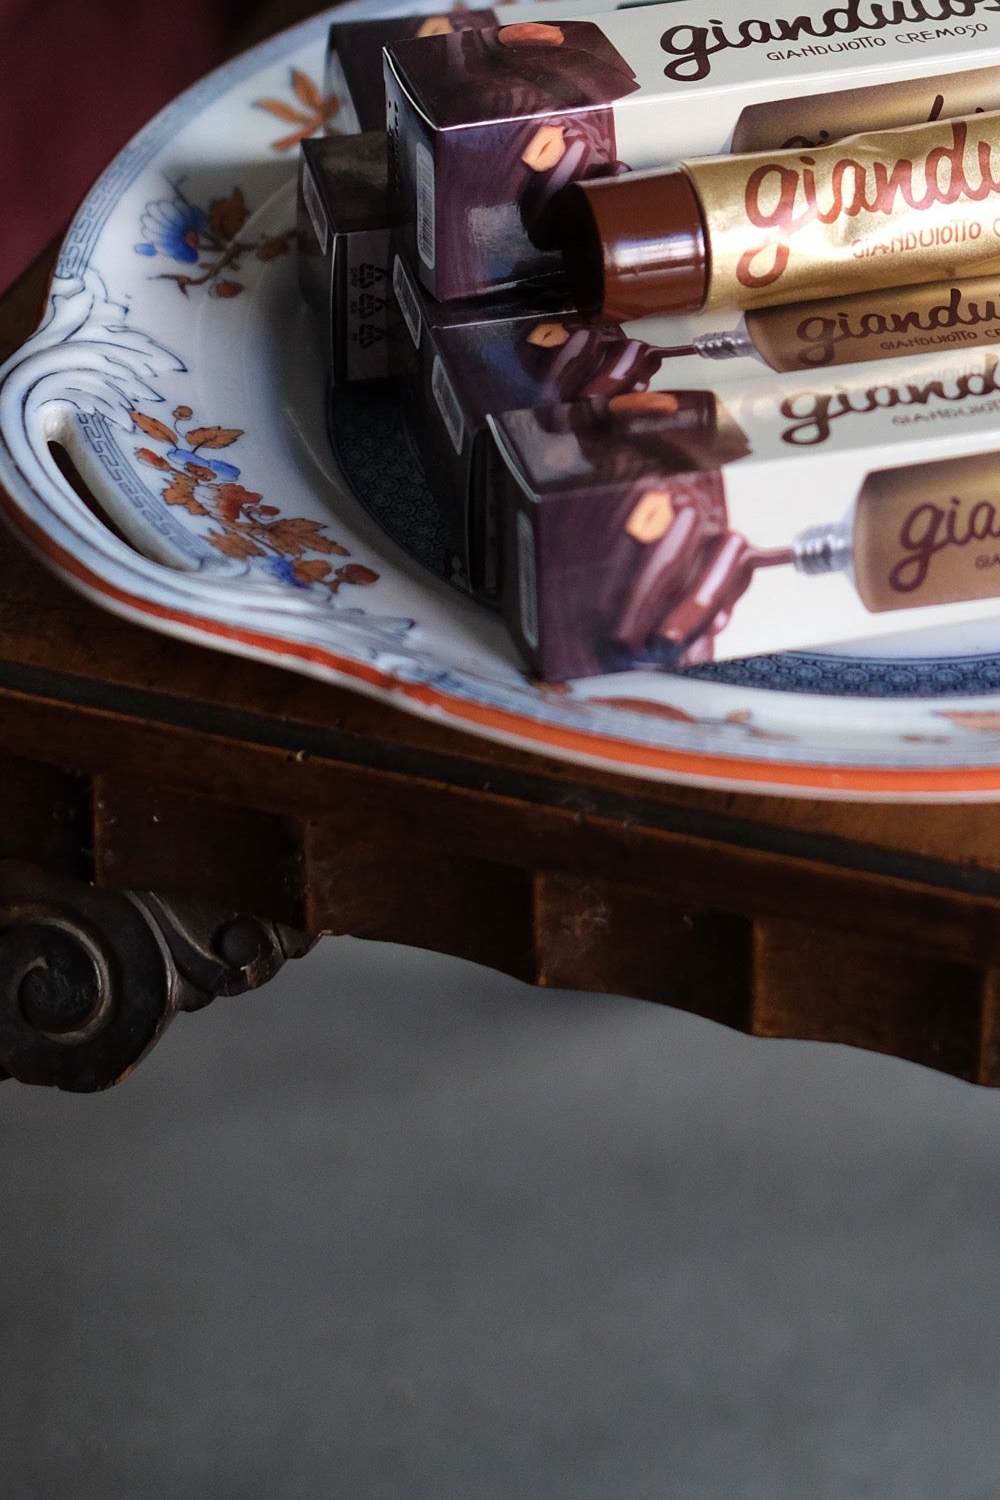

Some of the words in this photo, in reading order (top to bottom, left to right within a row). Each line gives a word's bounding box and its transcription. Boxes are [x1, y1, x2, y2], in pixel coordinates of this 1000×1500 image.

[766, 36, 886, 61] GIANDUIOTTO
[895, 22, 989, 45] CREMOSO
[850, 218, 982, 259] GIANDUIOTTO
[879, 331, 978, 350] GIANDUIOTTO
